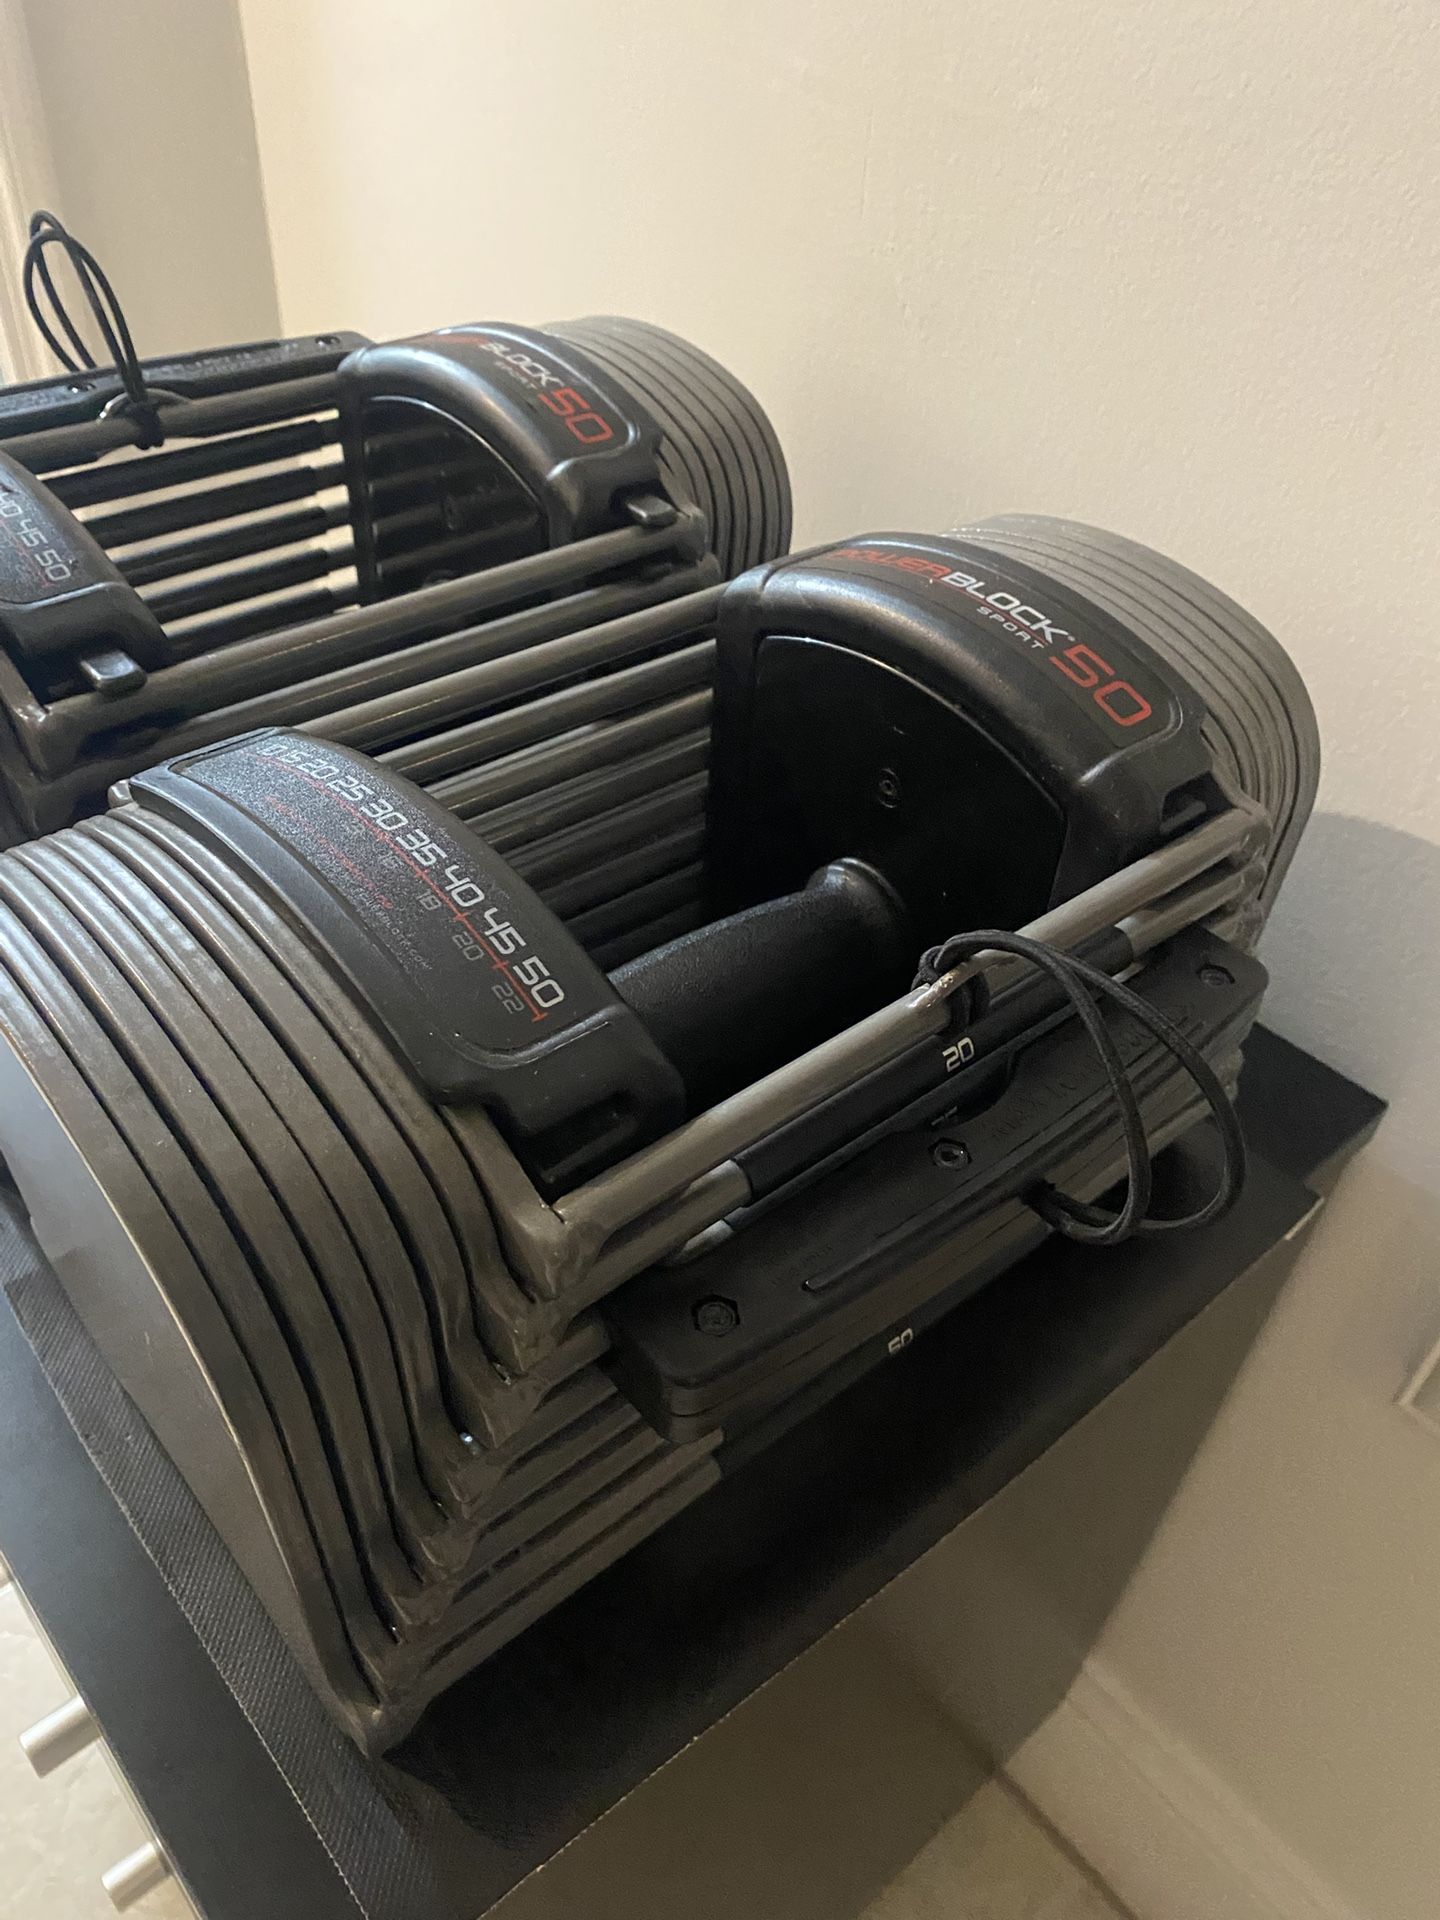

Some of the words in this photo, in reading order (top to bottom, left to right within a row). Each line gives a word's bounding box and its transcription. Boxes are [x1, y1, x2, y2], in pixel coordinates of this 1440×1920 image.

[537, 386, 615, 444] 50
[17, 518, 49, 548] 45
[34, 548, 71, 581] 50
[976, 606, 1045, 649] SPORT
[1050, 643, 1152, 726] 50
[296, 758, 339, 780] 20
[326, 774, 376, 802] 25
[360, 799, 409, 831] 30
[396, 828, 447, 867] 35
[444, 864, 485, 907] 40
[483, 907, 527, 955] 45
[512, 955, 565, 1008] 50
[416, 888, 442, 911] 18
[451, 930, 485, 962] 20
[491, 981, 525, 1014] 22
[942, 1036, 975, 1073] 20
